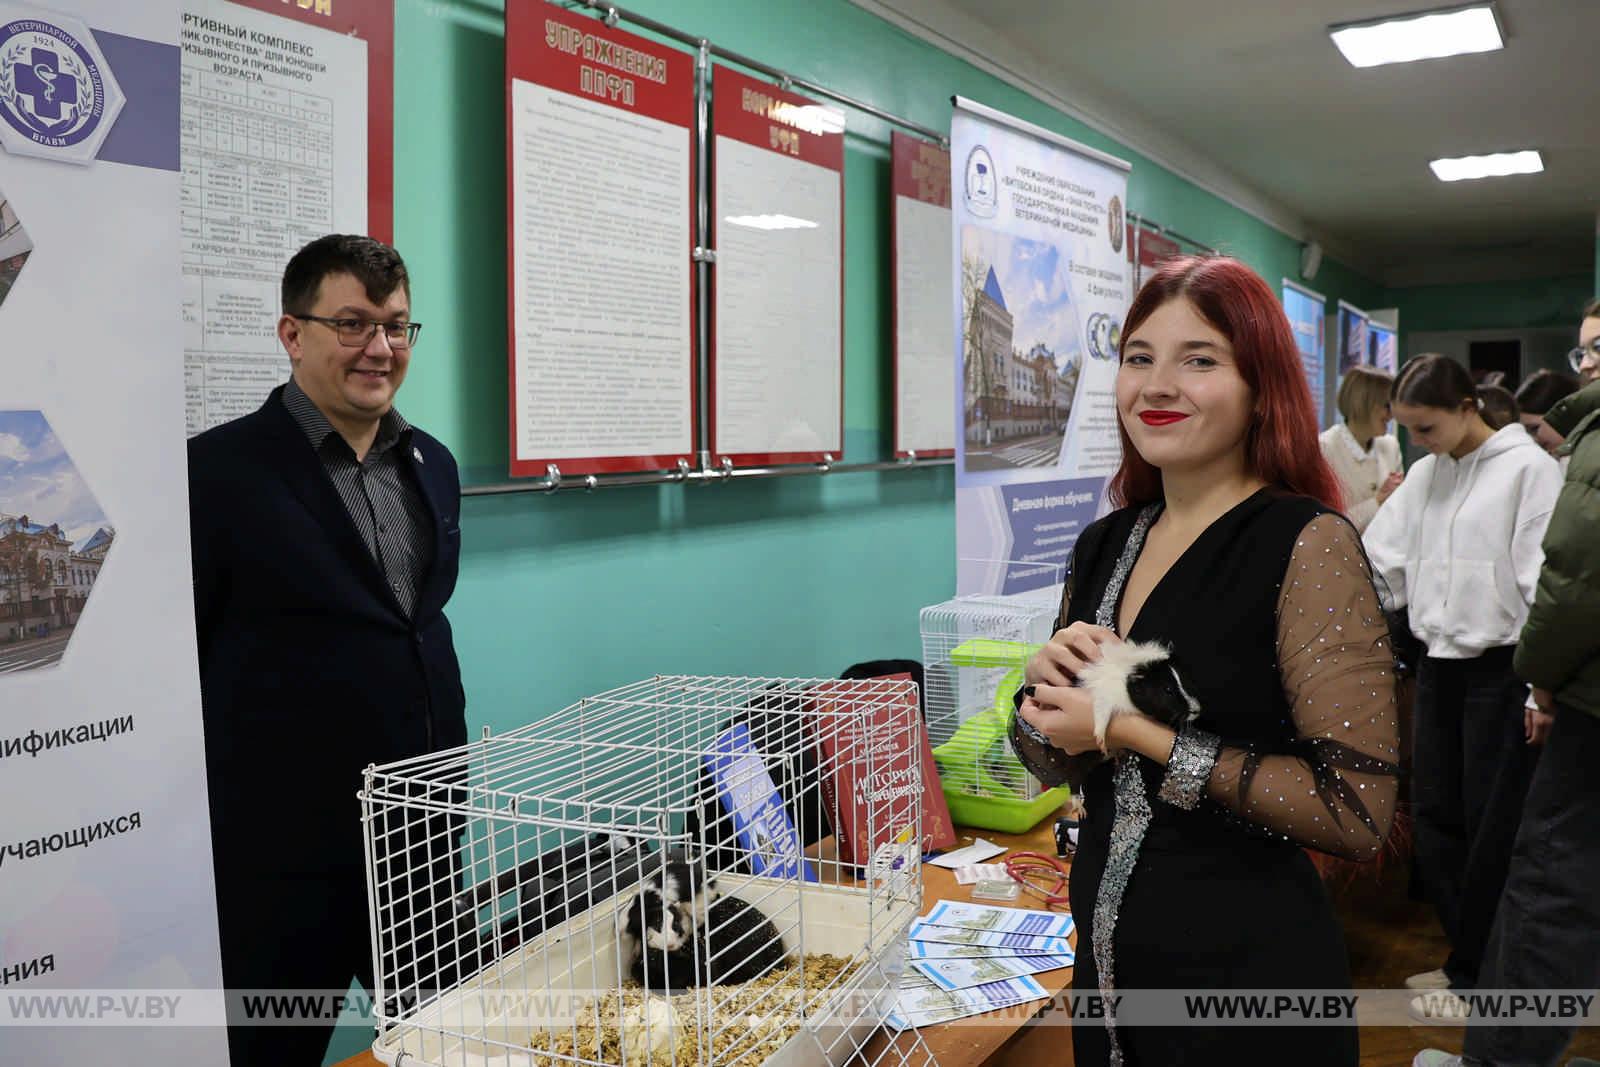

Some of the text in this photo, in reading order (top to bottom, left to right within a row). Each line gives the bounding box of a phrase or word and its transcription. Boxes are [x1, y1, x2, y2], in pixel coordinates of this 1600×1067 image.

[33, 35, 56, 48] 1924
[182, 13, 314, 57] РТИВНЫЙ КОМПЛЕКС
[265, 51, 283, 63] ДЛЯ
[286, 54, 327, 73] ЮНОШЕЙ
[545, 19, 667, 84] УПРАЖНЕНИЯ
[213, 63, 263, 83] ВОЗРАСТА
[242, 57, 249, 67] И
[250, 60, 313, 83] ПРИЗЫВНОГО
[580, 65, 636, 107] ППФП
[0, 954, 55, 985] ния
